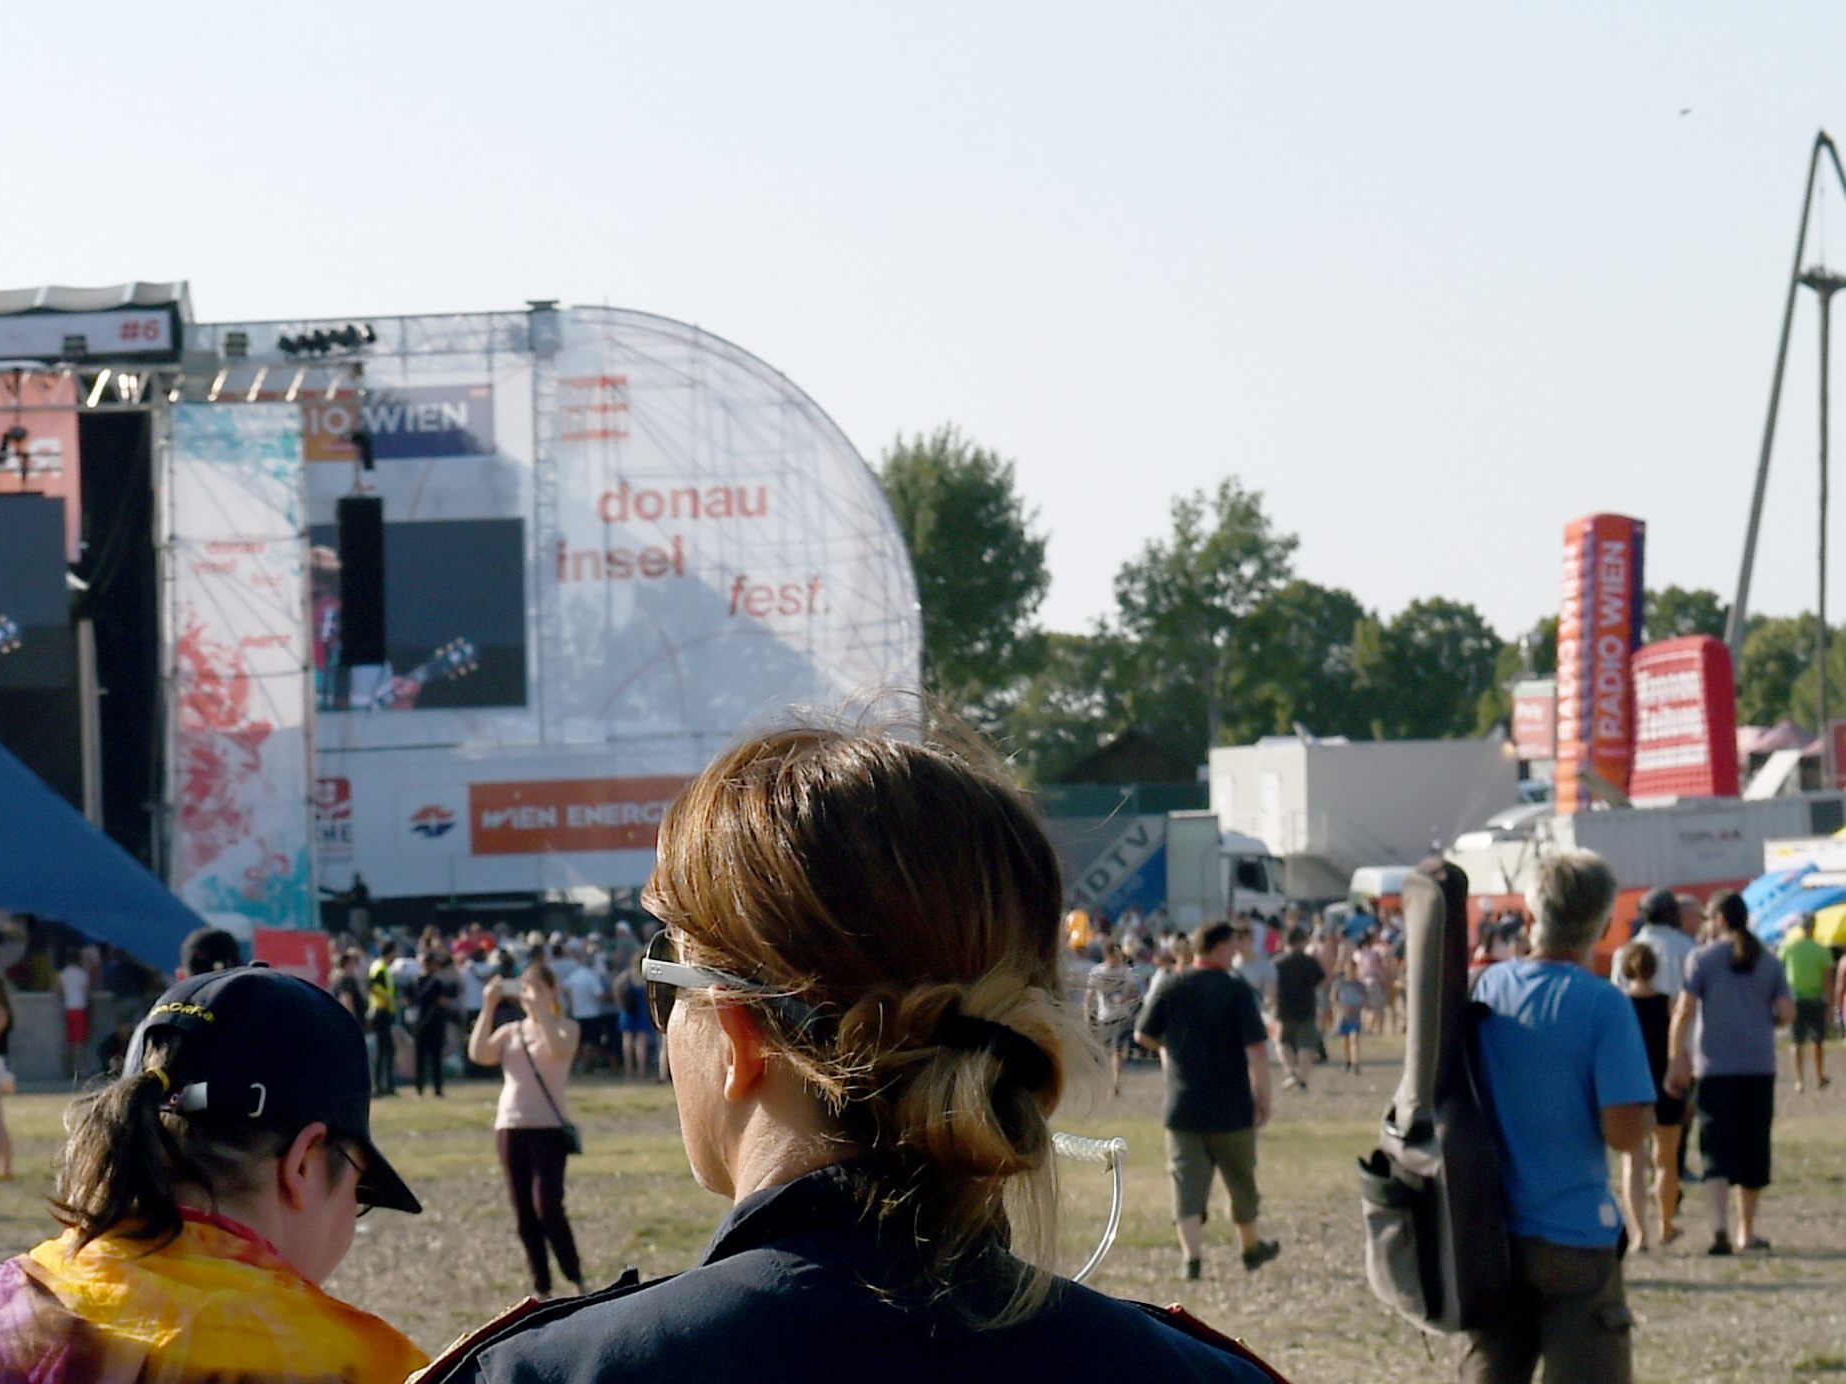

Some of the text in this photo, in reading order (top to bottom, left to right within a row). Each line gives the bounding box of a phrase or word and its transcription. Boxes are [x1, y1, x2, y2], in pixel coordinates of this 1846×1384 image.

[119, 319, 160, 341] #6
[362, 401, 469, 434] WIEN
[596, 480, 769, 525] donau
[556, 534, 685, 583] insel
[727, 573, 831, 619] fest.
[1597, 540, 1627, 739] RADIO WIEN
[480, 805, 558, 830] WIEN
